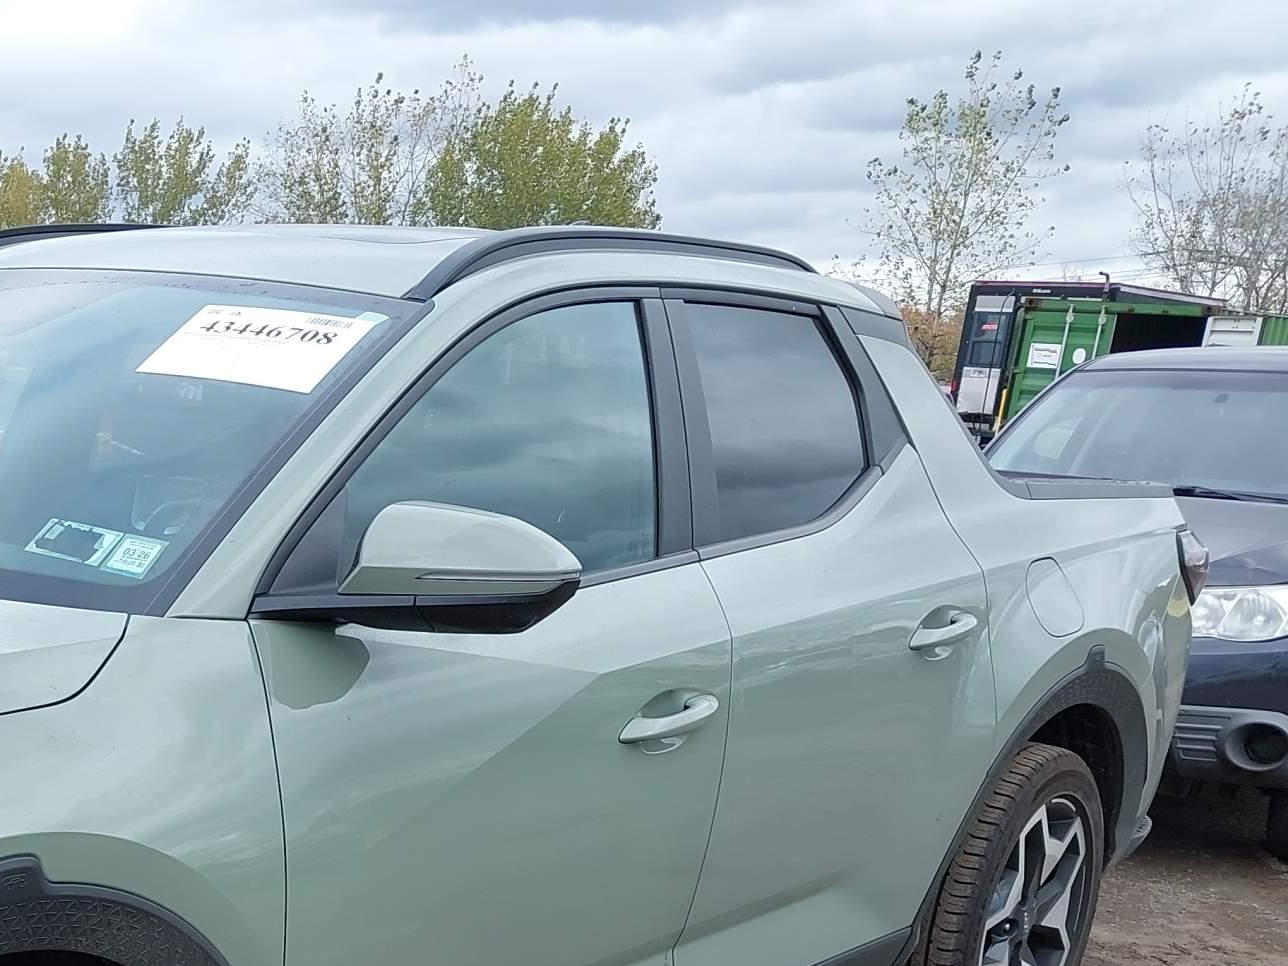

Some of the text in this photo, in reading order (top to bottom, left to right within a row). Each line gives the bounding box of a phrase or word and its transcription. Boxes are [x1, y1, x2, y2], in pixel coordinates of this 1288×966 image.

[200, 320, 338, 344] 43446708
[122, 547, 152, 560] 03 26
